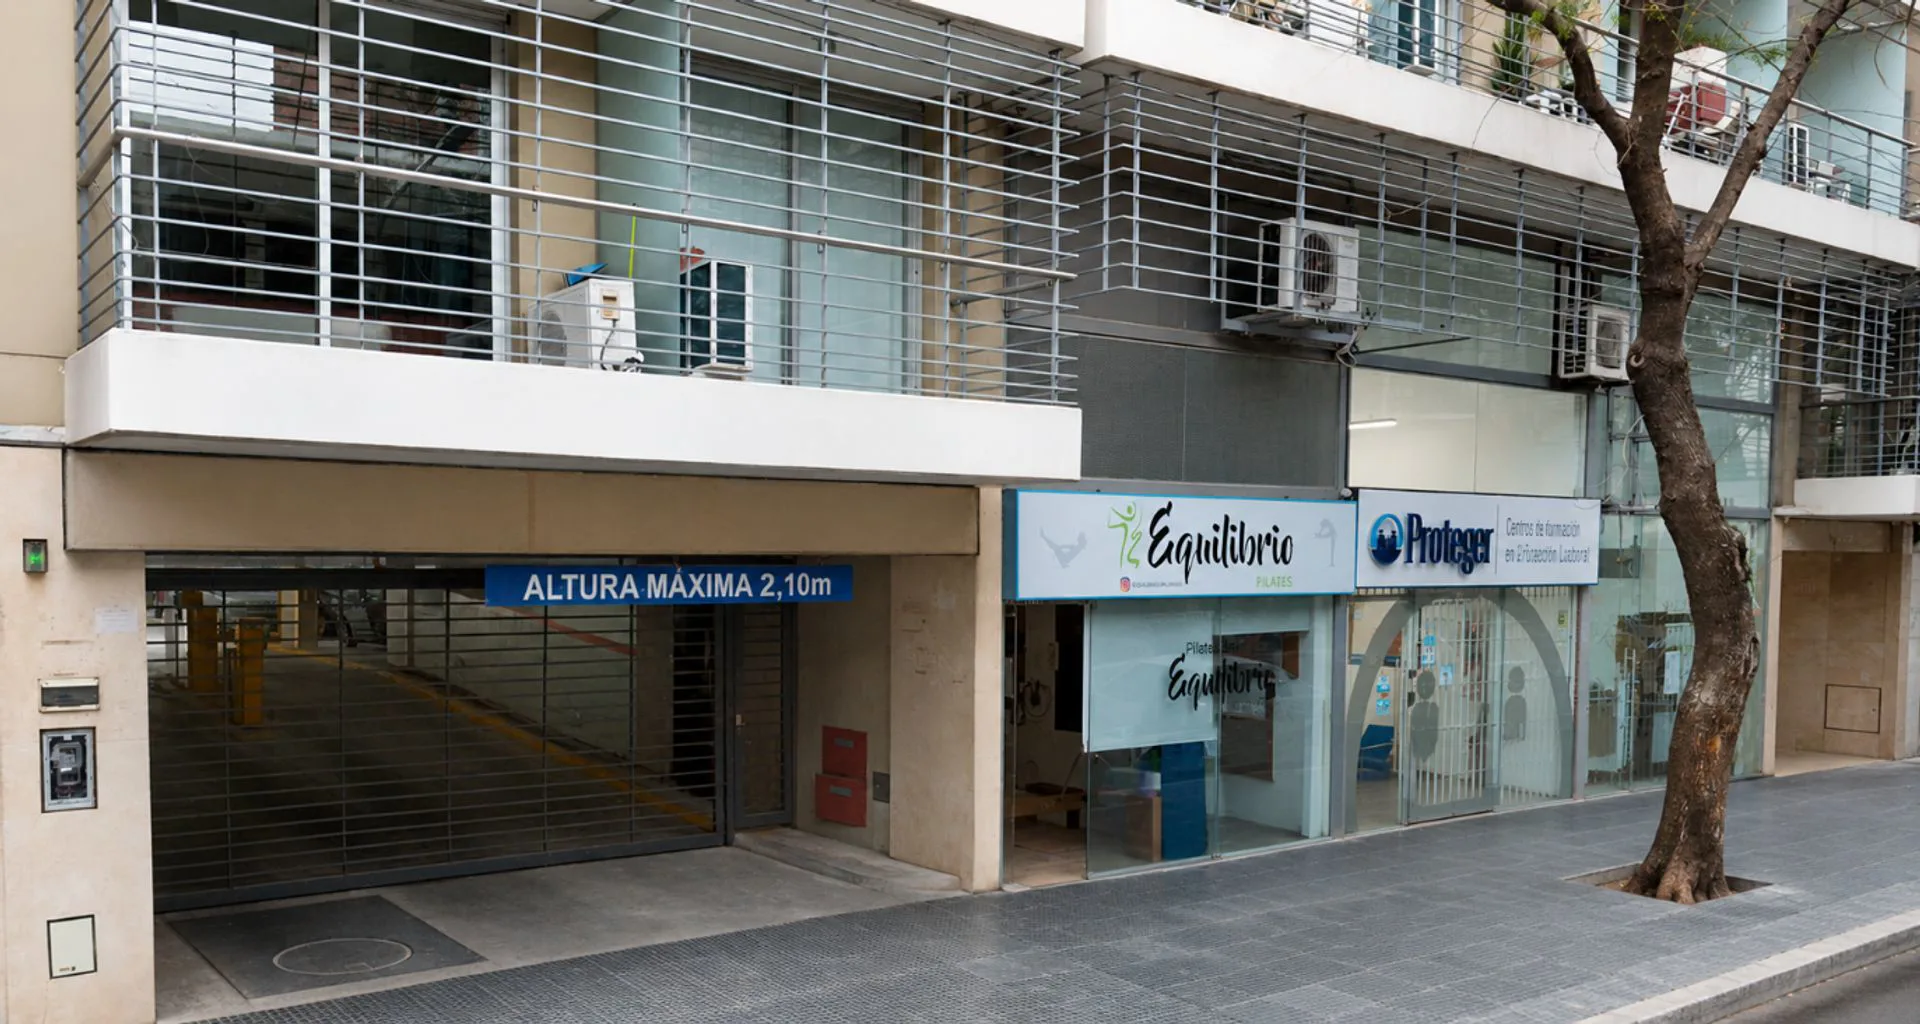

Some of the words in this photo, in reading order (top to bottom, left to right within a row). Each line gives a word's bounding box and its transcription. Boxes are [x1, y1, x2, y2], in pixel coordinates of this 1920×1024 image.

[1506, 517, 1533, 536] Centros
[1535, 520, 1544, 536] de
[1148, 501, 1293, 584] Equilibrio
[1404, 513, 1494, 574] Proteger
[1505, 548, 1514, 562] en
[523, 573, 640, 600] ALTURA
[647, 567, 753, 598] MÁXIMA
[759, 572, 832, 601] 2,10m
[1256, 575, 1293, 588] PILATES
